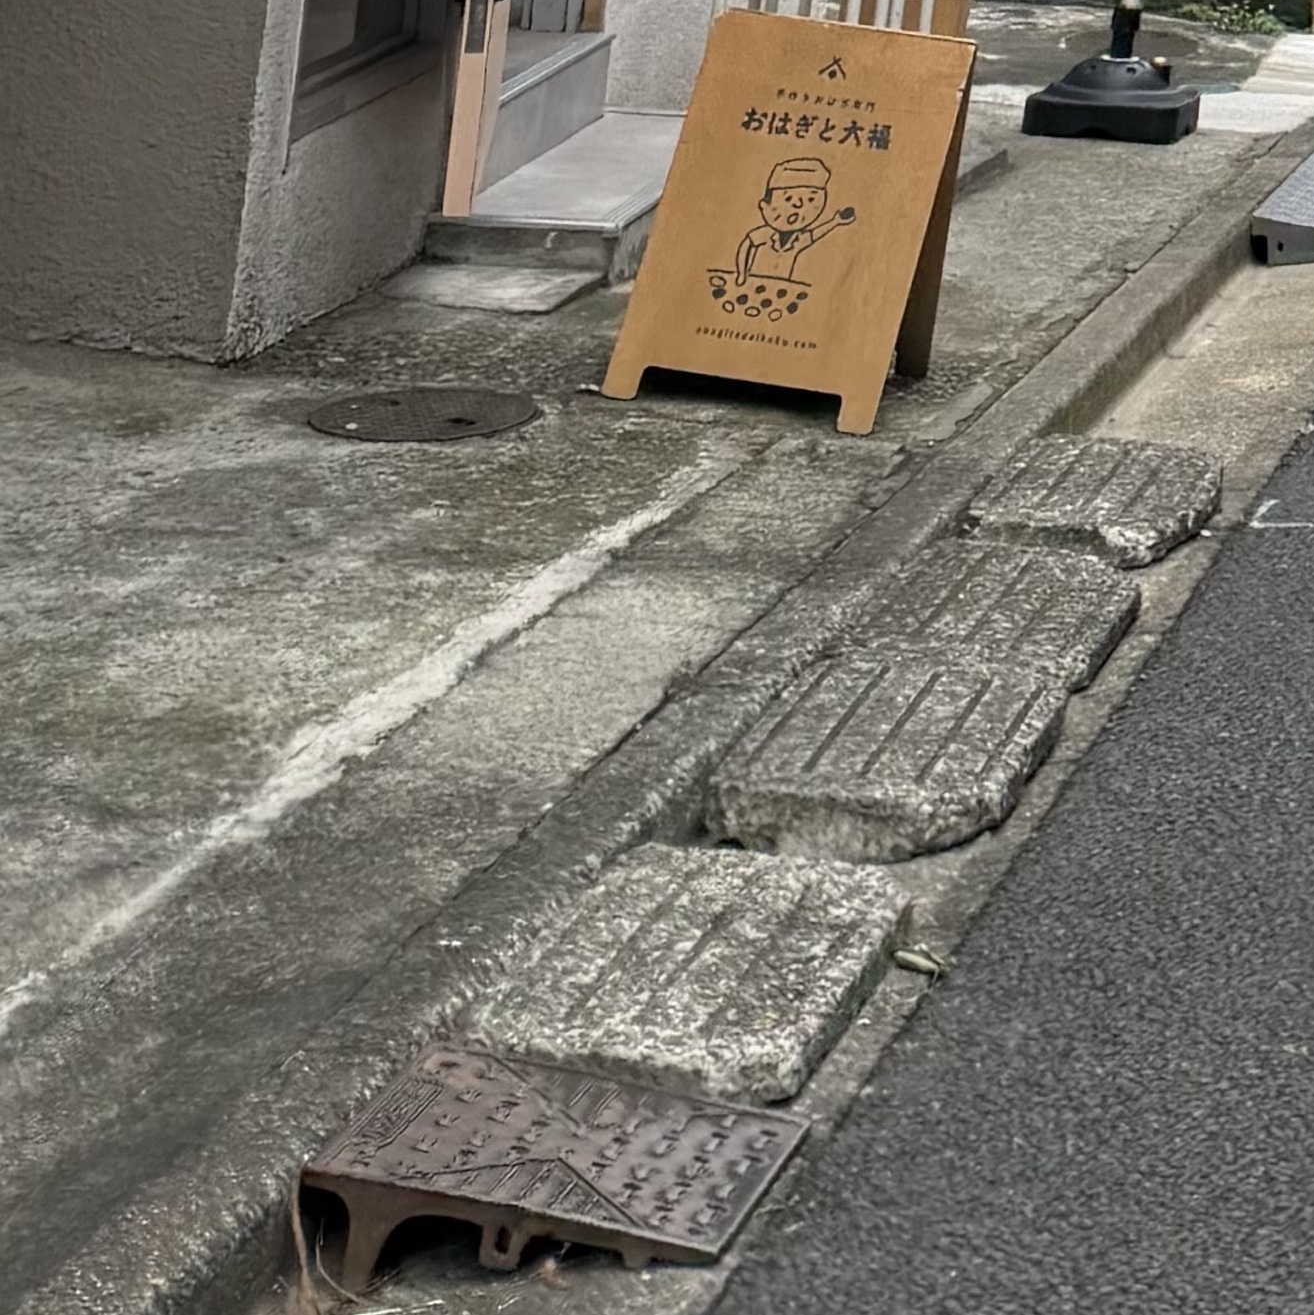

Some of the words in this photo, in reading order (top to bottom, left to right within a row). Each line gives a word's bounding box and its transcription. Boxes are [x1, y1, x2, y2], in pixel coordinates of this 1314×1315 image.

[741, 105, 893, 151] おはぎと大福
